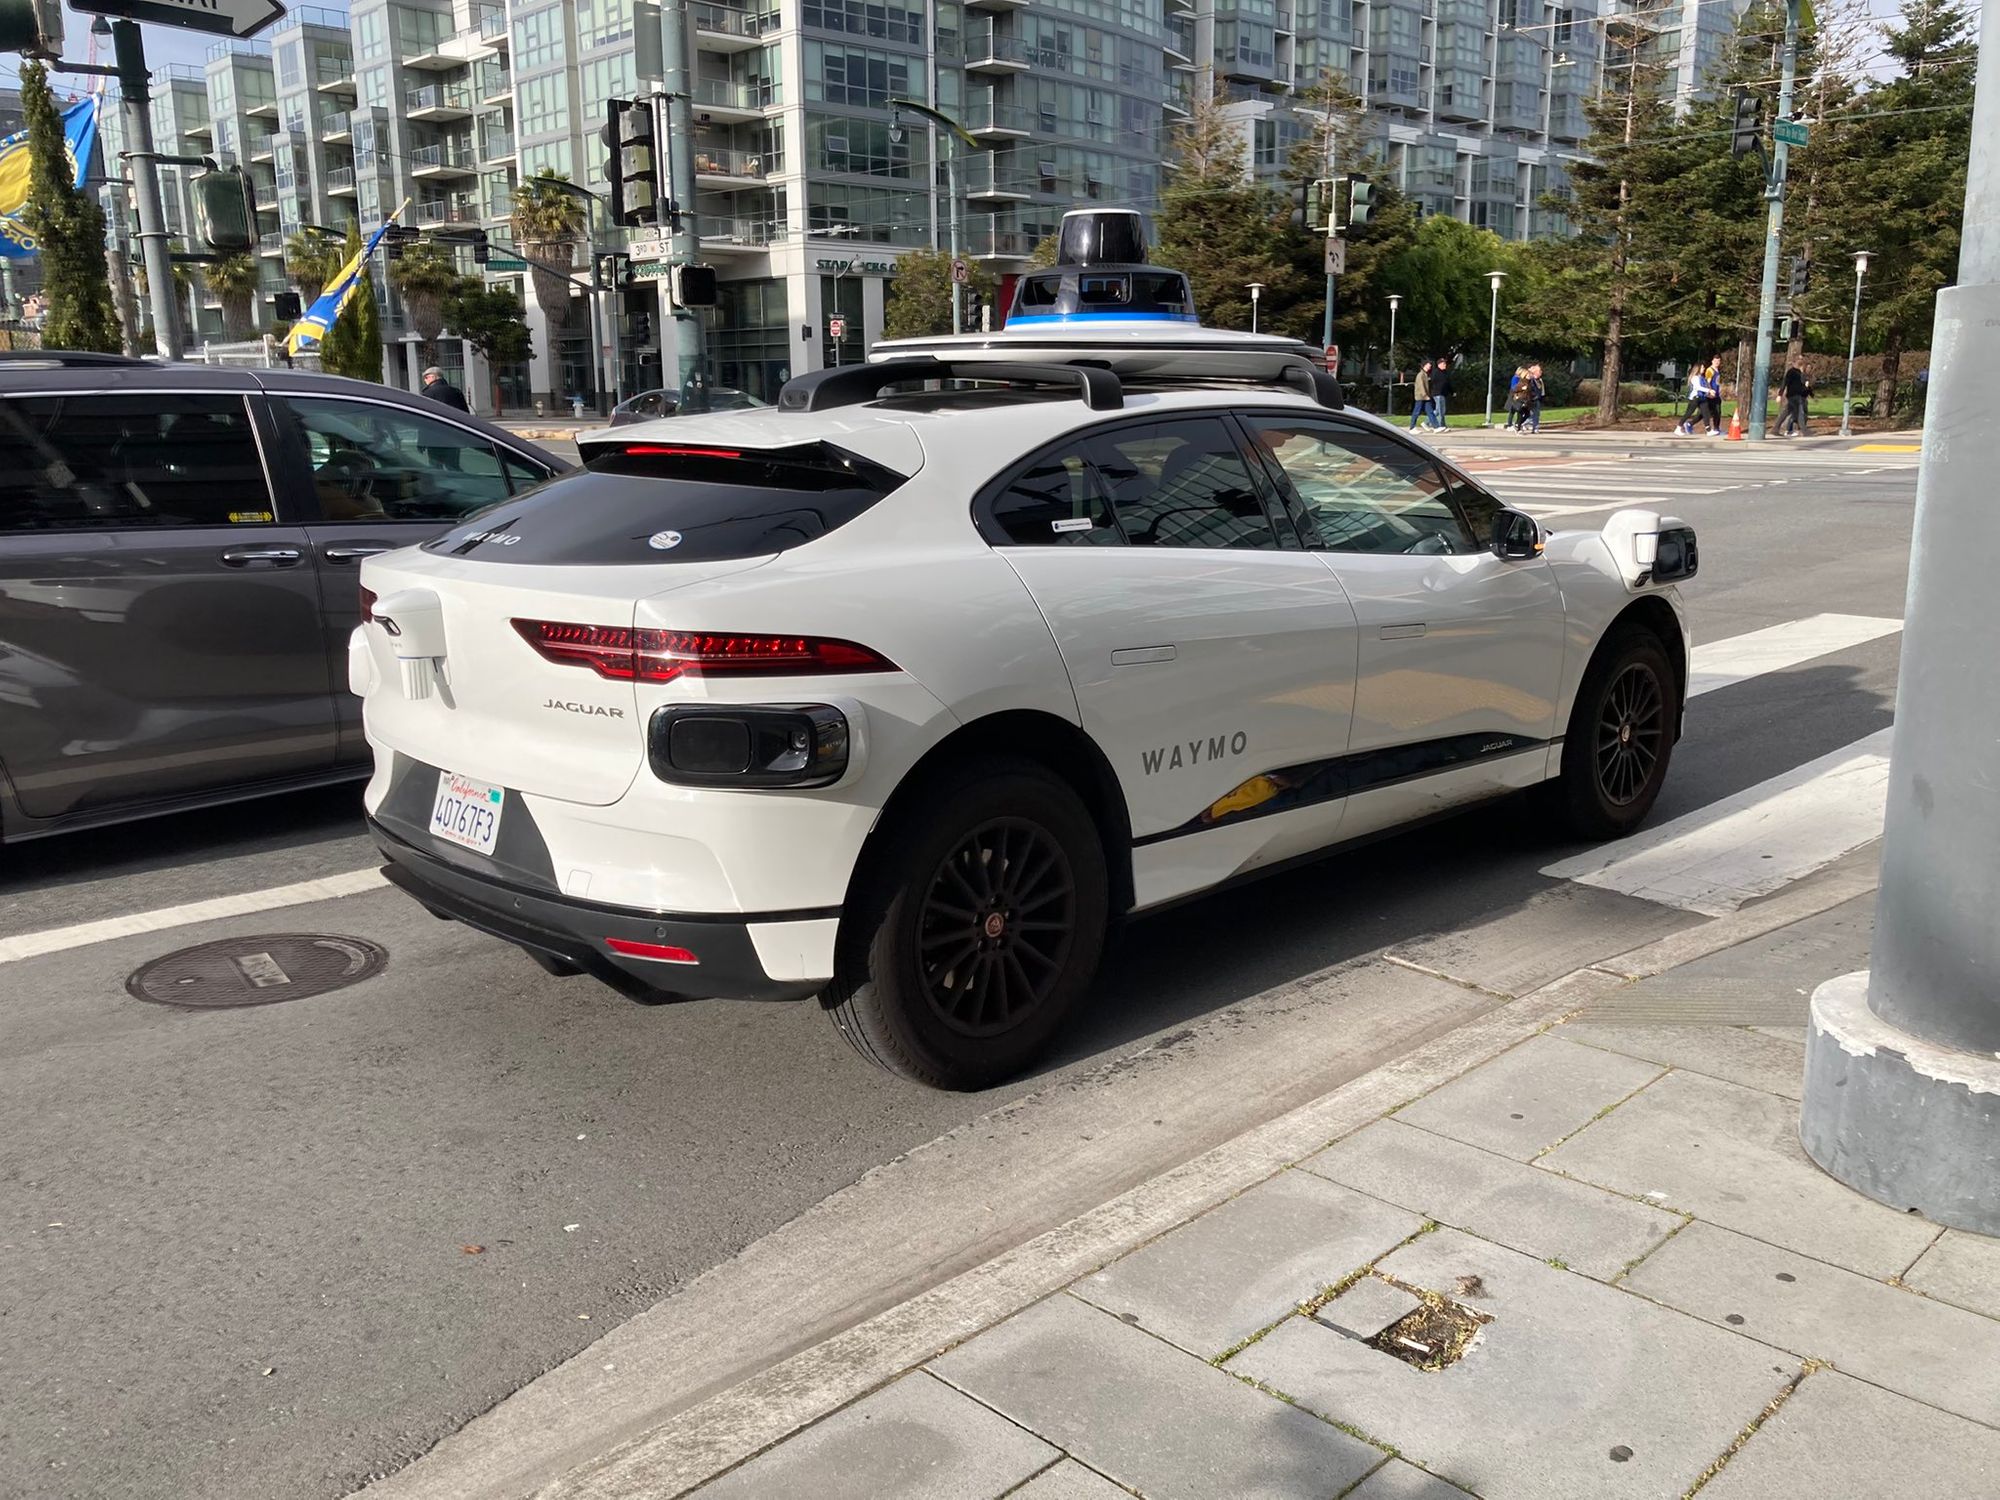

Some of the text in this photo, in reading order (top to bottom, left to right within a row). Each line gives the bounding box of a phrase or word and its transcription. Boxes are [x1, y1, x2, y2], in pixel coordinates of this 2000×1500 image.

[659, 241, 670, 253] ST
[816, 259, 887, 272] STARCKS
[462, 531, 521, 546] WAYMO
[543, 698, 624, 718] JAGUAR
[1142, 731, 1247, 775] WAYMO
[1480, 740, 1512, 752] JAGUAR
[450, 777, 489, 802] California
[435, 794, 494, 843] 40767F3
